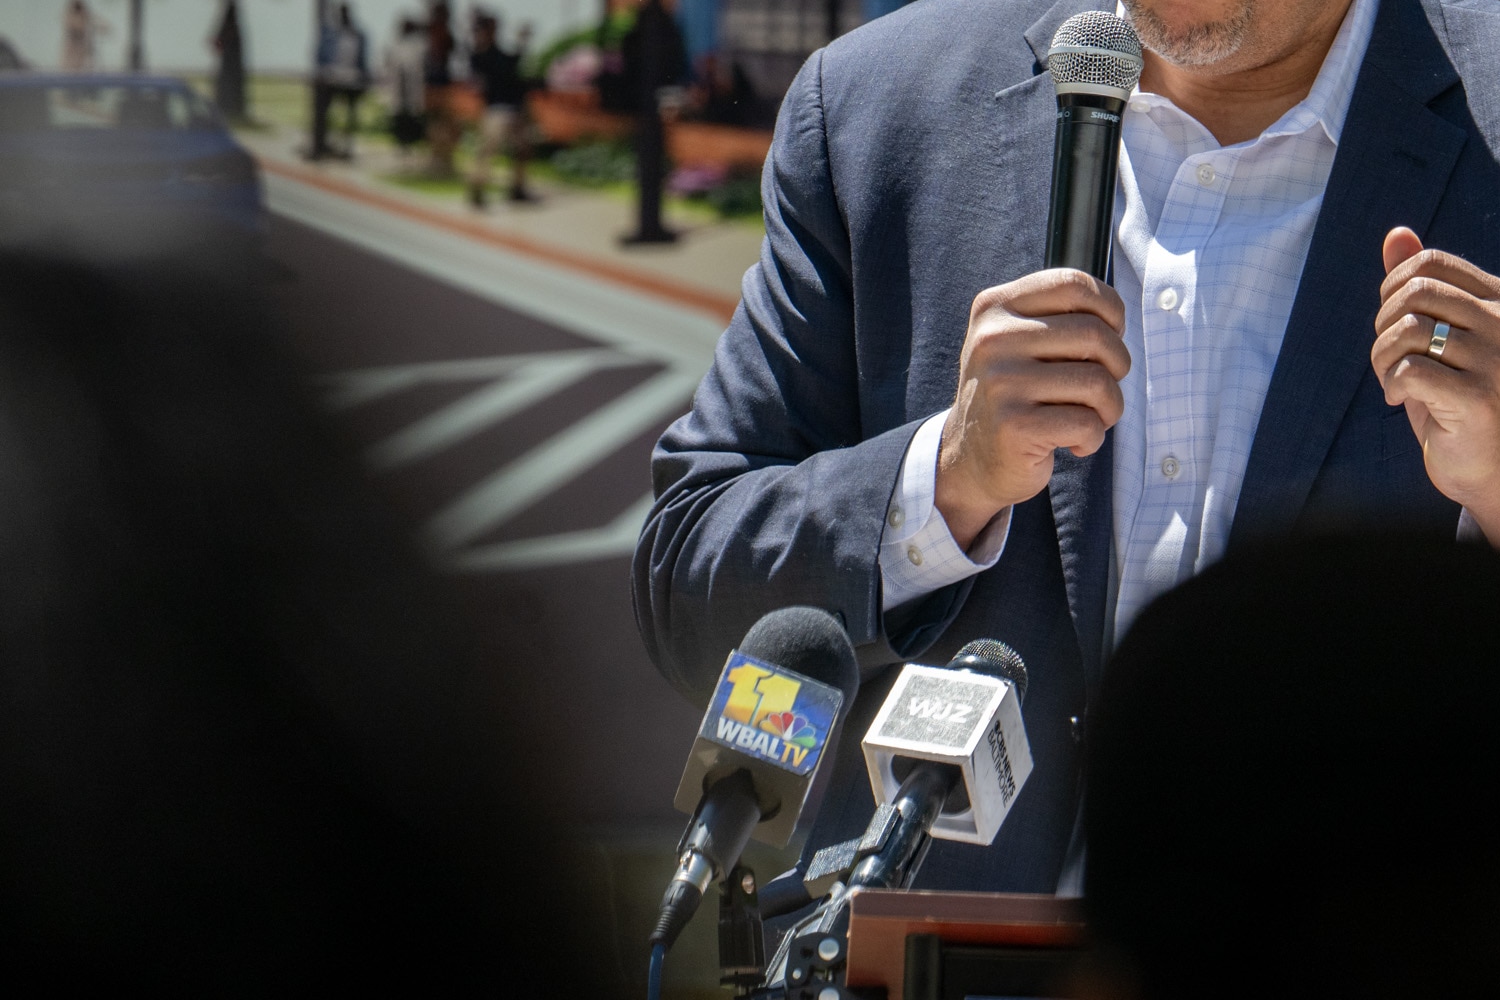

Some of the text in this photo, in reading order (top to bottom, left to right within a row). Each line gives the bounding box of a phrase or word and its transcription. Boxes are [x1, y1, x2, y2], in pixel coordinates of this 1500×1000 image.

[1090, 111, 1120, 123] SHURE
[722, 662, 801, 728] 11
[907, 697, 973, 723] WJZ
[987, 729, 1010, 808] BALTIMORE
[996, 731, 1016, 798] CBS NEWS
